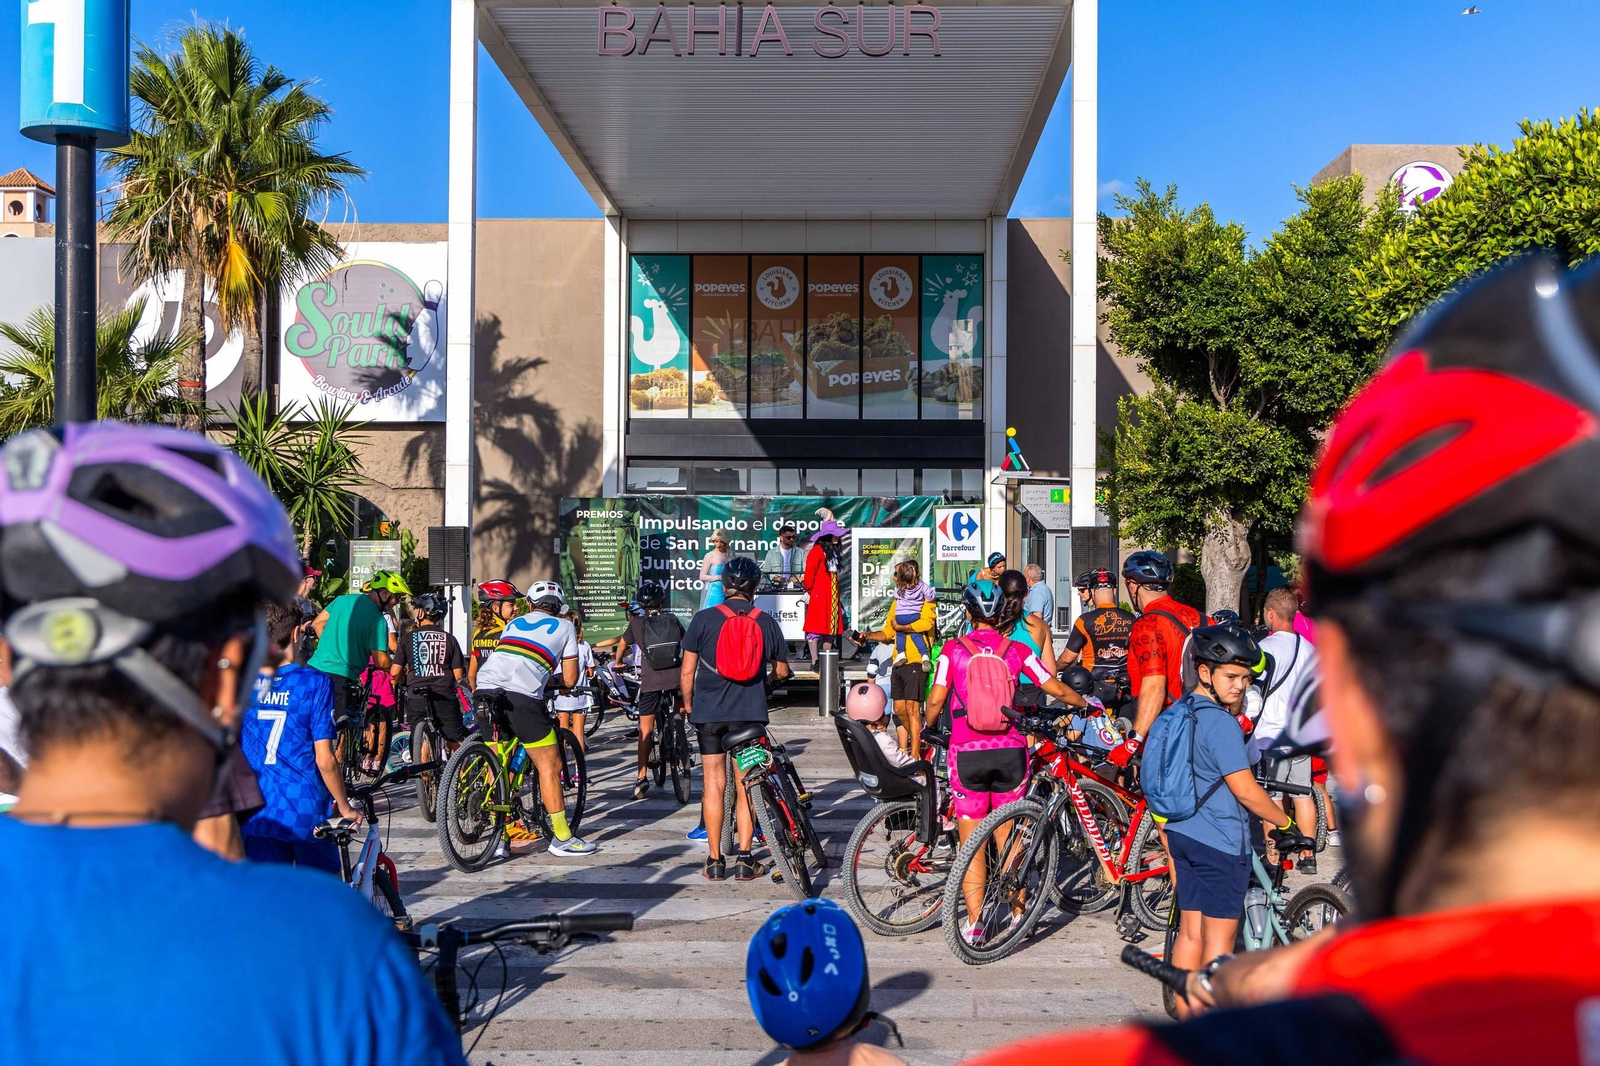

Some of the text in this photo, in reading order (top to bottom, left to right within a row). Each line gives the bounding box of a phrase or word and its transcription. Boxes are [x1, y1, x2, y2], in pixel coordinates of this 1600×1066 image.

[598, 4, 942, 58] BAHIA SUR
[762, 269, 793, 281] LOUISIANA
[875, 269, 907, 281] LOUISIANA
[764, 297, 792, 307] KITCHEN
[877, 297, 905, 307] KITCHEN
[323, 333, 412, 368] Park
[312, 374, 413, 405] Bowling & Arcade
[576, 510, 624, 518] PREMIOS
[640, 516, 846, 534] Impulsando el depoe
[640, 535, 780, 550] de San Frnand
[352, 565, 370, 574] Día
[862, 562, 890, 575] Día
[352, 579, 363, 588] Bi
[659, 576, 704, 590] victo
[862, 576, 890, 586] de la
[862, 587, 894, 598] Bicic
[419, 632, 445, 640] VANS
[474, 639, 499, 648] JUMBO
[419, 664, 445, 677] WALL
[259, 690, 290, 706] ANTÉ
[257, 709, 287, 765] 7
[1068, 782, 1111, 862] SPECIALIZED
